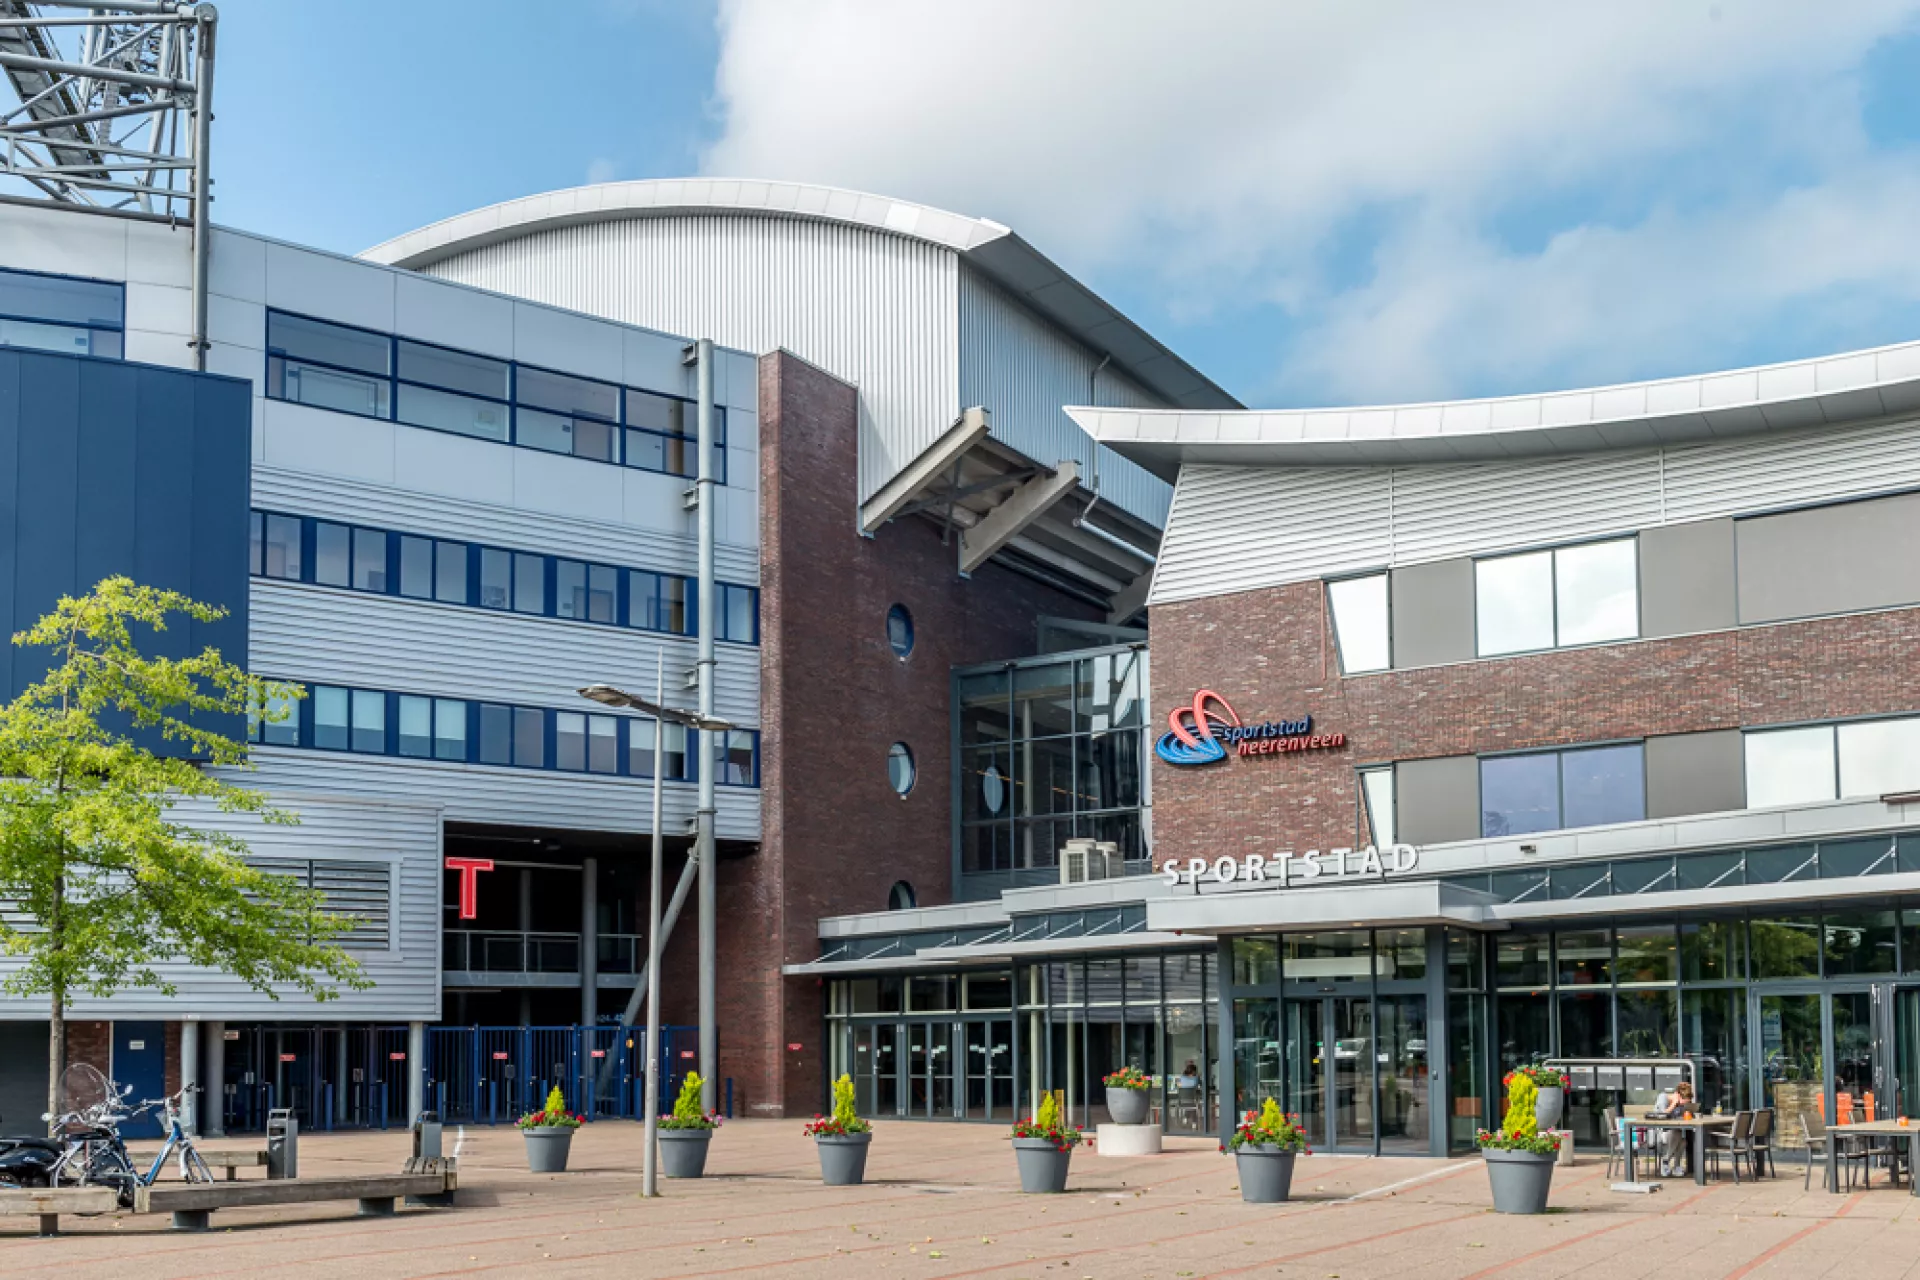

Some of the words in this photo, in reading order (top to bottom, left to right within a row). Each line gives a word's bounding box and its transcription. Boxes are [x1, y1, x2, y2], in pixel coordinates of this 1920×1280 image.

[1223, 715, 1312, 745] sportstad
[1237, 732, 1345, 757] heerenveen
[1162, 842, 1420, 888] SPORTSTAD
[445, 856, 494, 919] T
